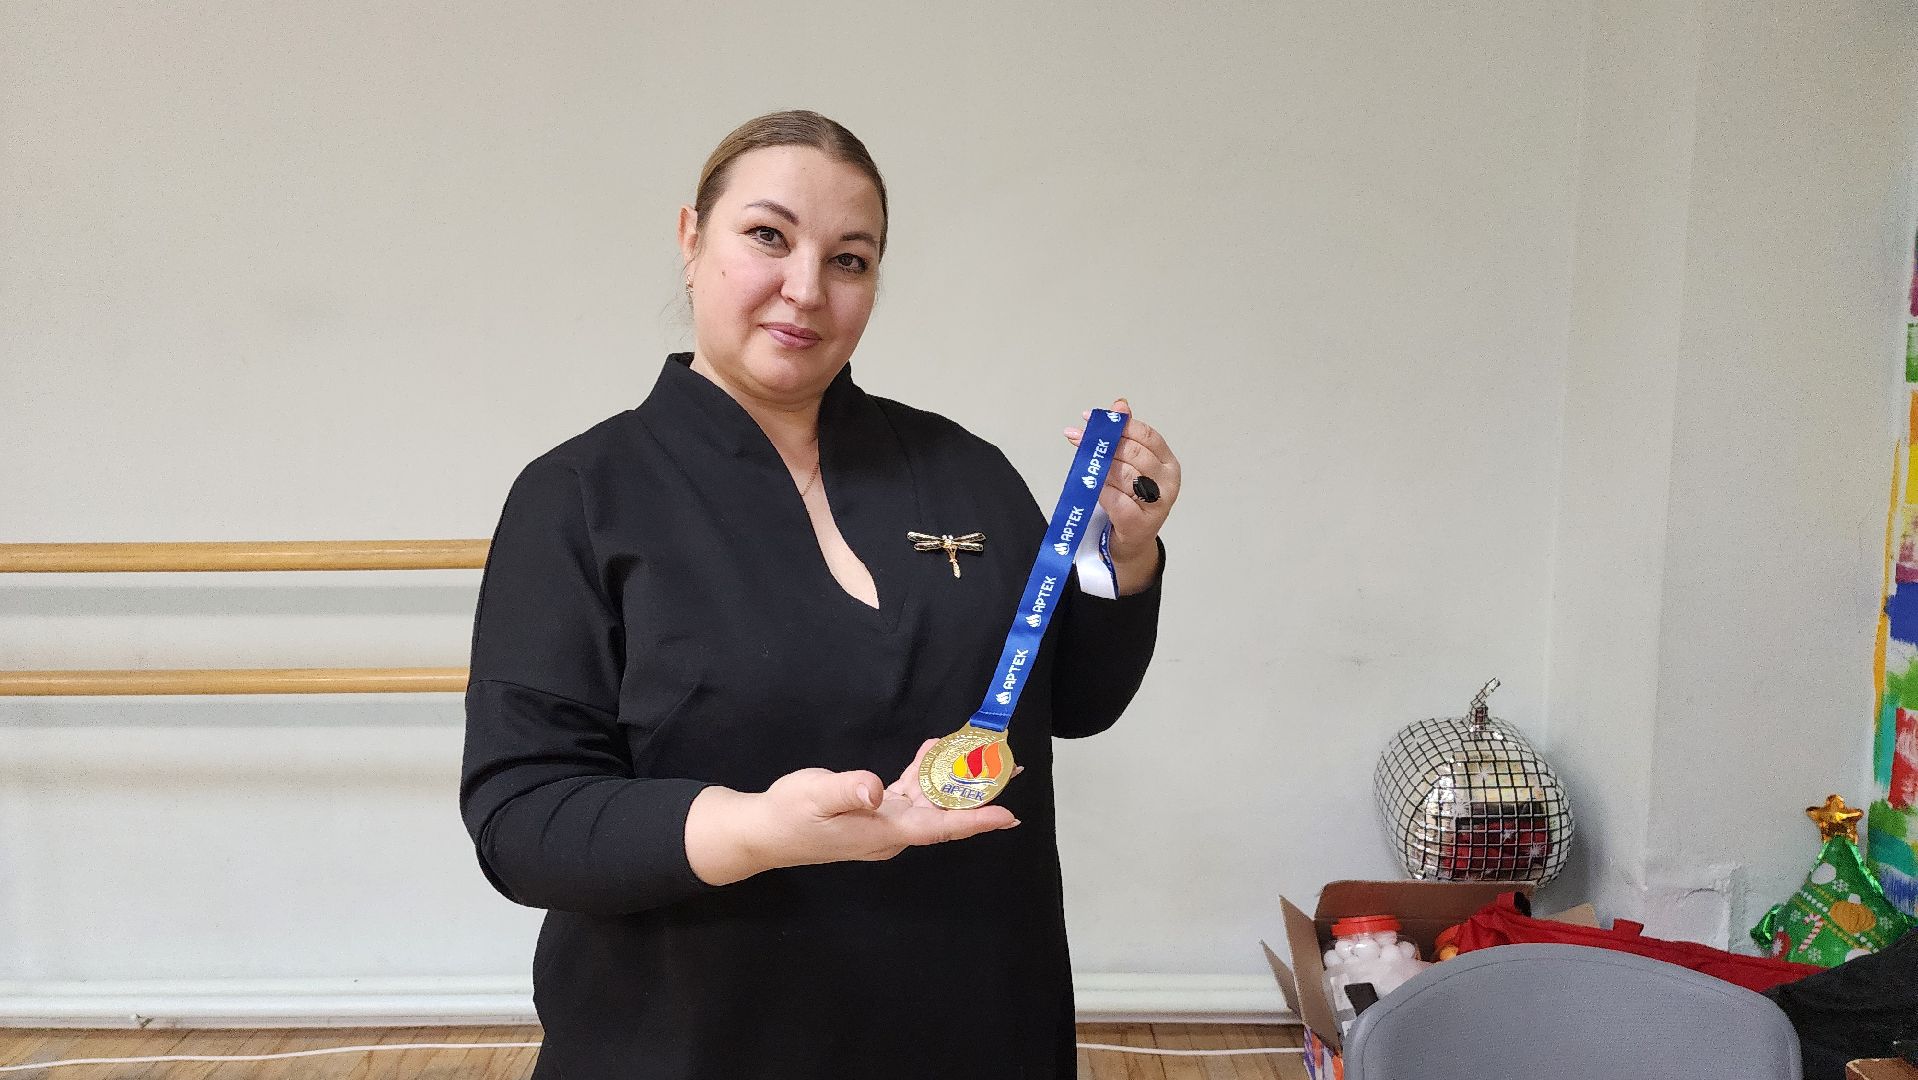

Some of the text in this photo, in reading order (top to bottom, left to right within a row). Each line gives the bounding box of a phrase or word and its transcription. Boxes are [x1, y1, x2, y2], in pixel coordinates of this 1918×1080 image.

[1087, 438, 1110, 476] АРТЕК
[1060, 506, 1084, 543] АРТЕК
[1032, 575, 1057, 612] АРТЕК
[1003, 649, 1029, 689] АРТЕК
[941, 783, 985, 801] АРТЕК
